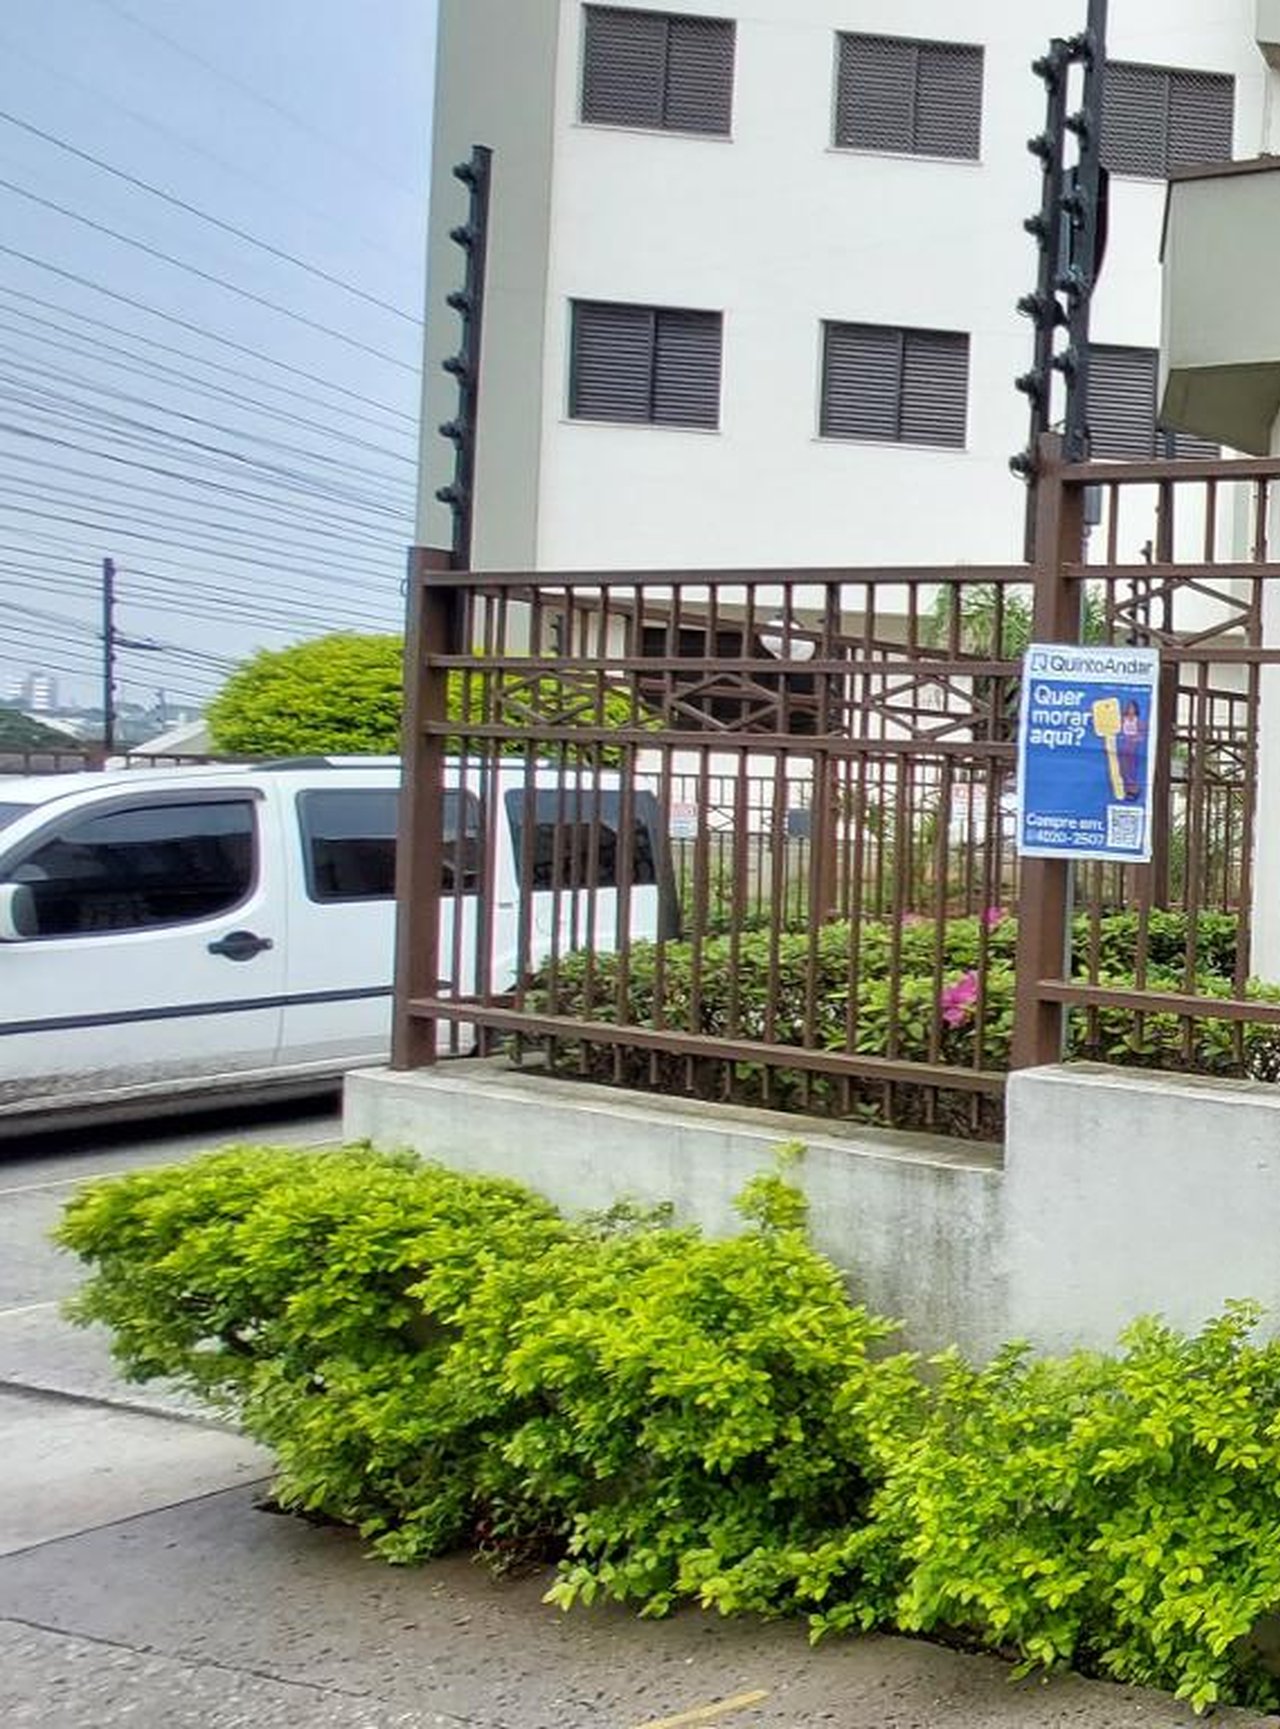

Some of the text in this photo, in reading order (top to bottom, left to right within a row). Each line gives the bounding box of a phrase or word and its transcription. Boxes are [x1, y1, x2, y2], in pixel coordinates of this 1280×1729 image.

[1050, 655, 1153, 675] QuintoAndar
[1034, 684, 1086, 706] Quer
[1031, 709, 1092, 726] morar
